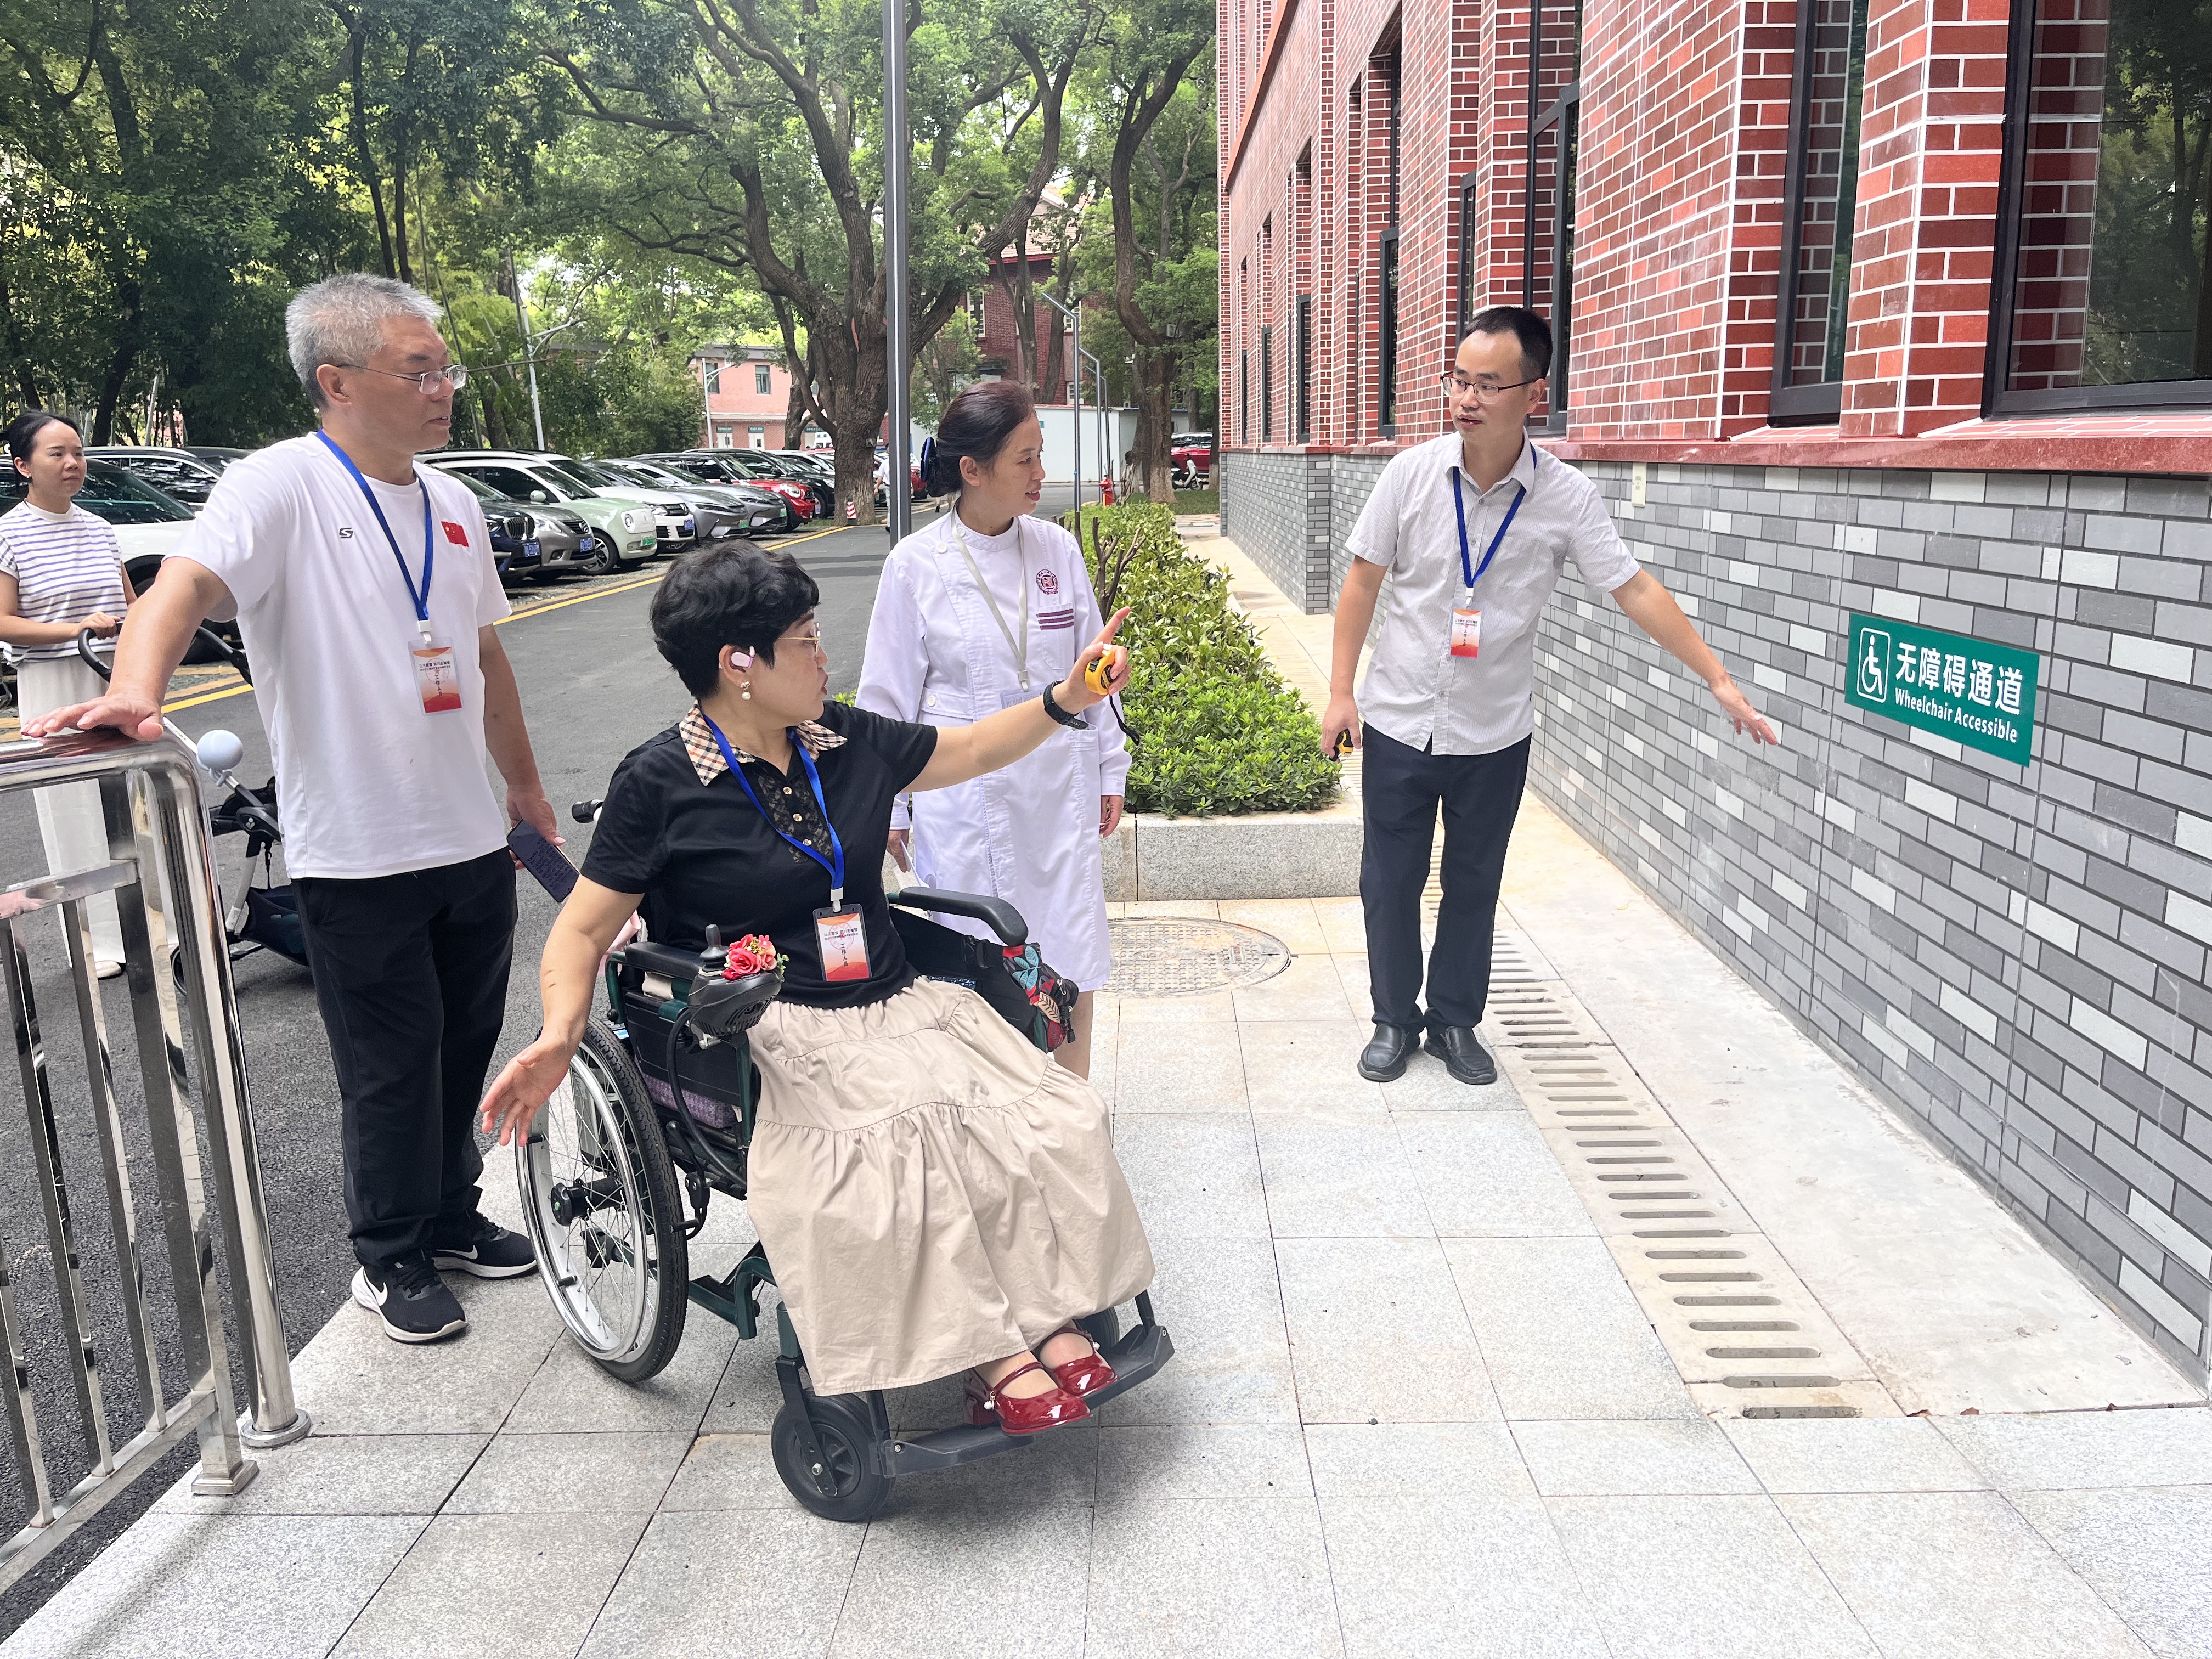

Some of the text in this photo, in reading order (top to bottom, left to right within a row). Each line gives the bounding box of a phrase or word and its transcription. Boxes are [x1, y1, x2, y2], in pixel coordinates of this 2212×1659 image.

[1895, 642, 2023, 715] 无障碍通道
[1895, 687, 2017, 743] Wheelchair Accessible
